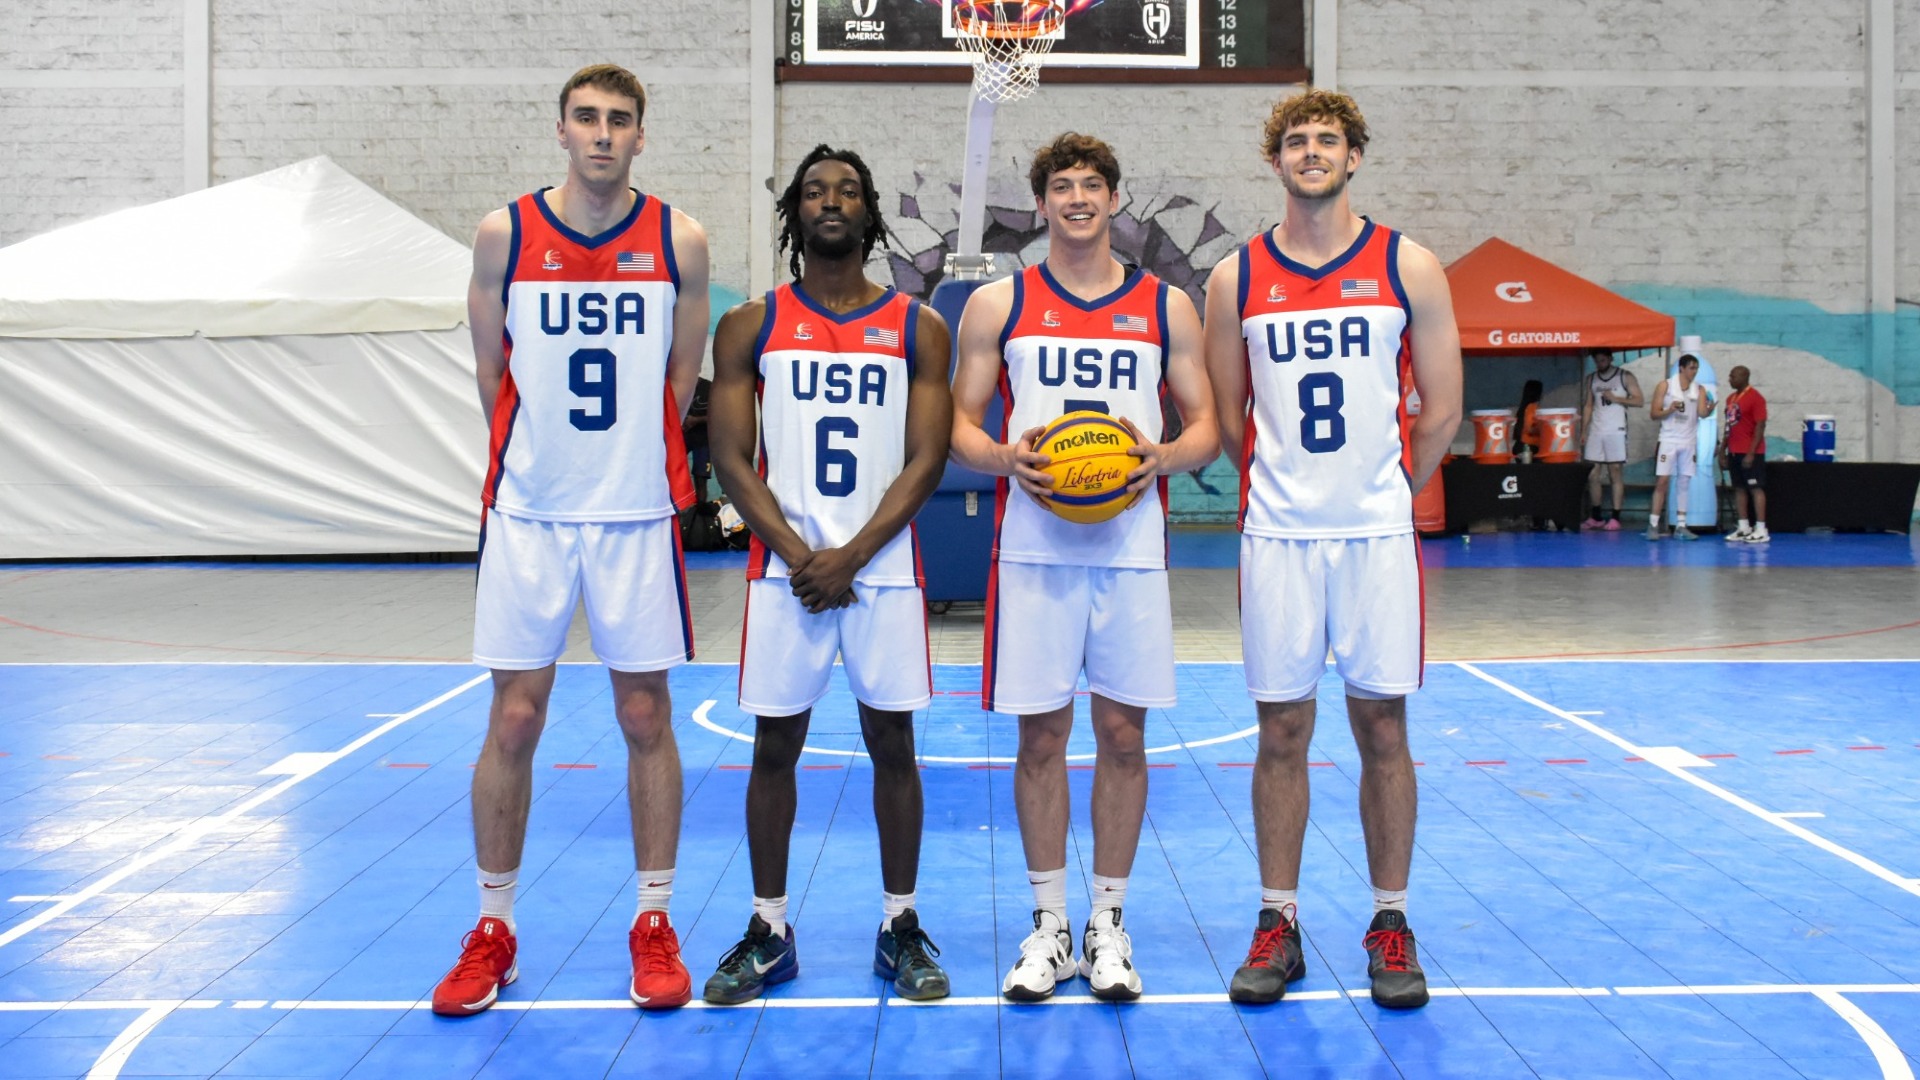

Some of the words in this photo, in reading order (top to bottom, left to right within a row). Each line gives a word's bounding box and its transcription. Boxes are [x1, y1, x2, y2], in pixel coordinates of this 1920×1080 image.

[791, 13, 801, 27] 7
[845, 20, 885, 32] FISU
[1217, 14, 1237, 29] 13
[790, 31, 801, 46] 8
[845, 32, 885, 40] AMERICA
[1217, 34, 1237, 49] 14
[790, 50, 801, 65] 9
[1217, 53, 1237, 68] 15
[1495, 282, 1533, 303] G
[540, 292, 645, 336] USA
[1266, 316, 1370, 364] USA
[1488, 329, 1503, 346] G
[1507, 331, 1581, 345] GATORADE
[1038, 346, 1138, 391] USA
[568, 347, 617, 432] 9
[791, 359, 887, 407] USA
[1297, 371, 1347, 454] 8
[1488, 423, 1503, 440] G
[1555, 421, 1570, 438] G
[1053, 431, 1120, 454] molten
[815, 415, 859, 498] 6
[1060, 462, 1122, 489] Libertria
[1502, 475, 1518, 493] G
